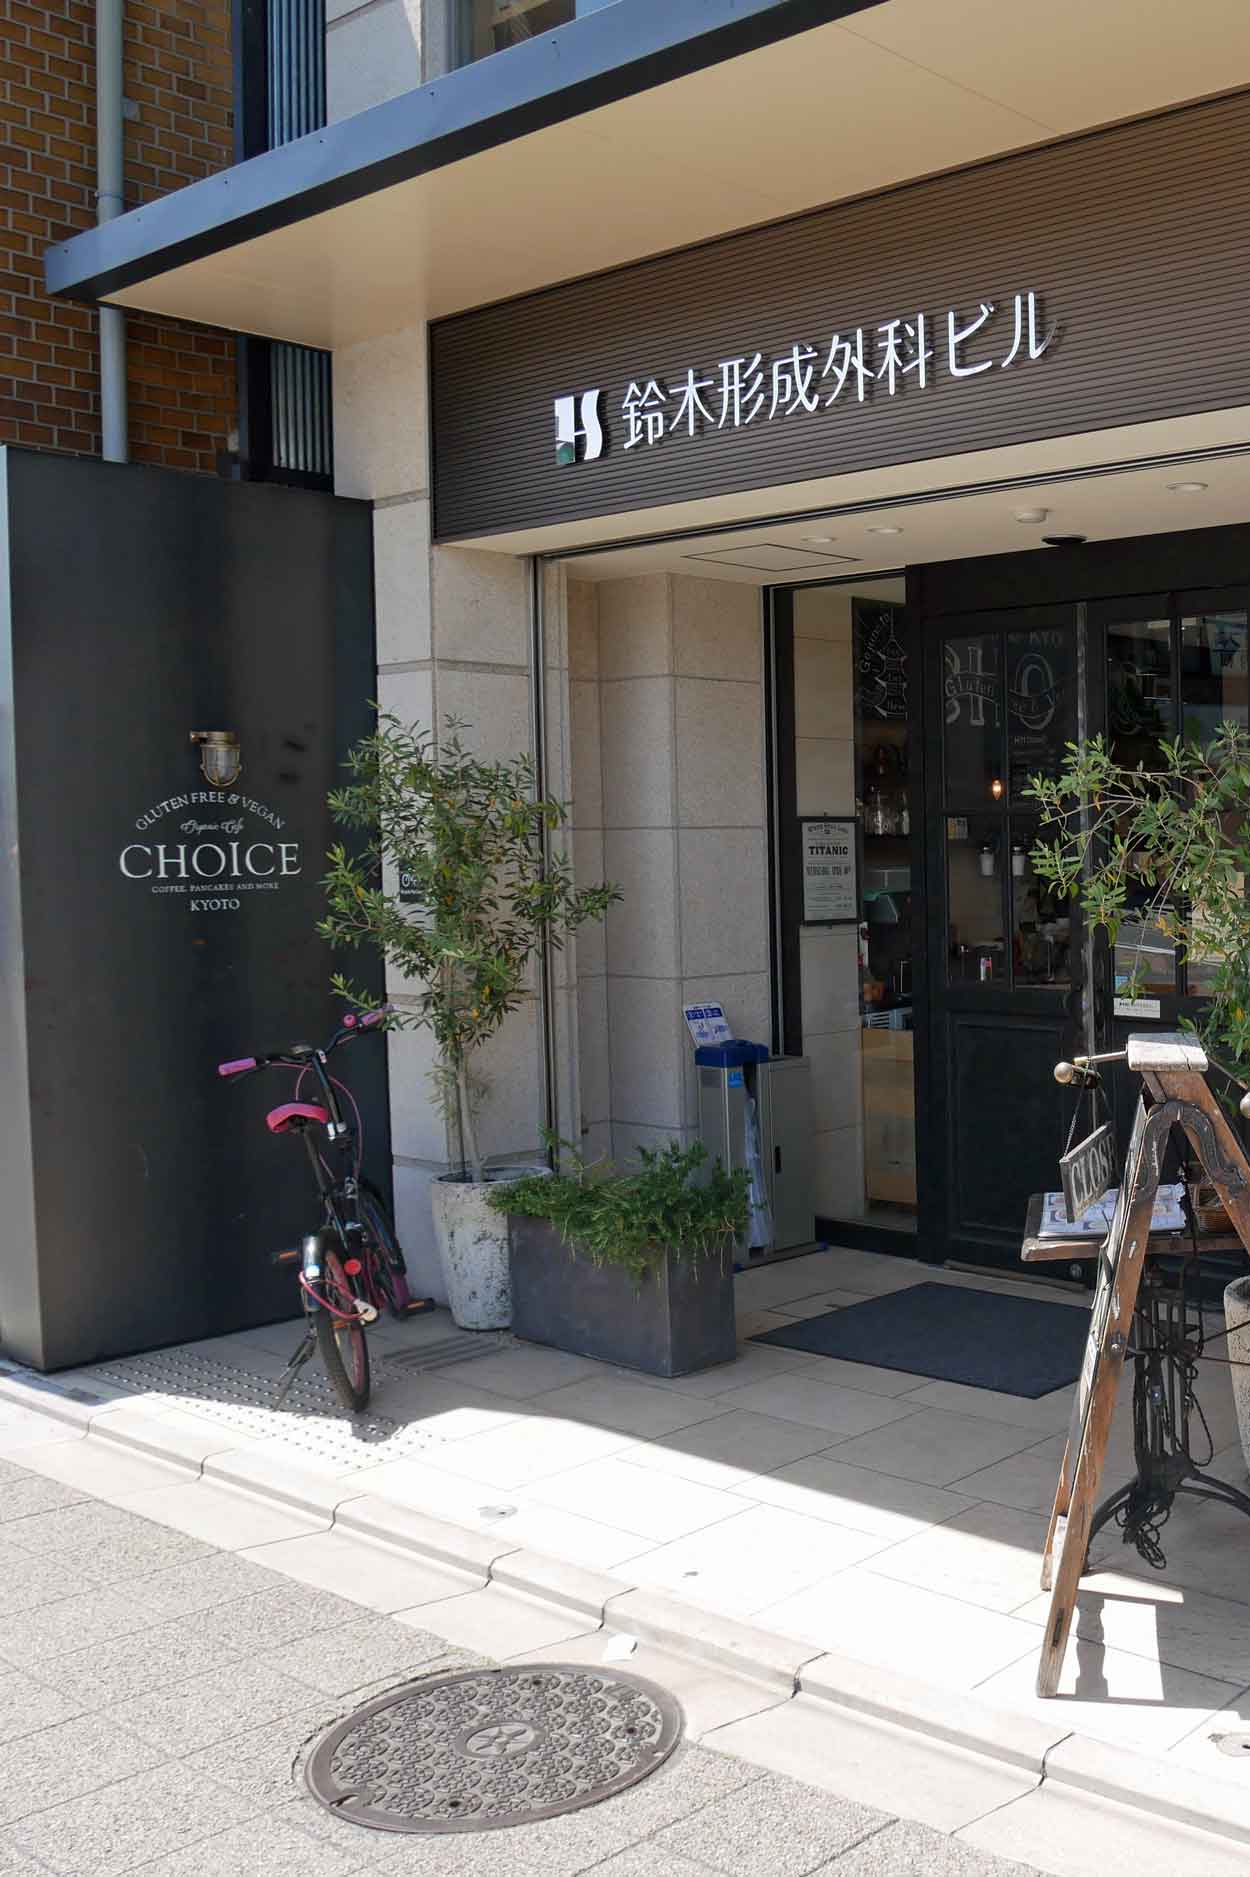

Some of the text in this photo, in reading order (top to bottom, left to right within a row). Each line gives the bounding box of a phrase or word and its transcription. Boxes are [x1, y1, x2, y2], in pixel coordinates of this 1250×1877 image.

[622, 292, 1058, 450] 鈴木形成外科ビル
[135, 791, 286, 831] GLUTEN FREE & VEGAN
[118, 841, 302, 879] CHOICE
[808, 846, 849, 856] TITANIC
[190, 882, 235, 893] PANCAKES
[236, 881, 256, 891] AND
[190, 897, 241, 912] KYOTO
